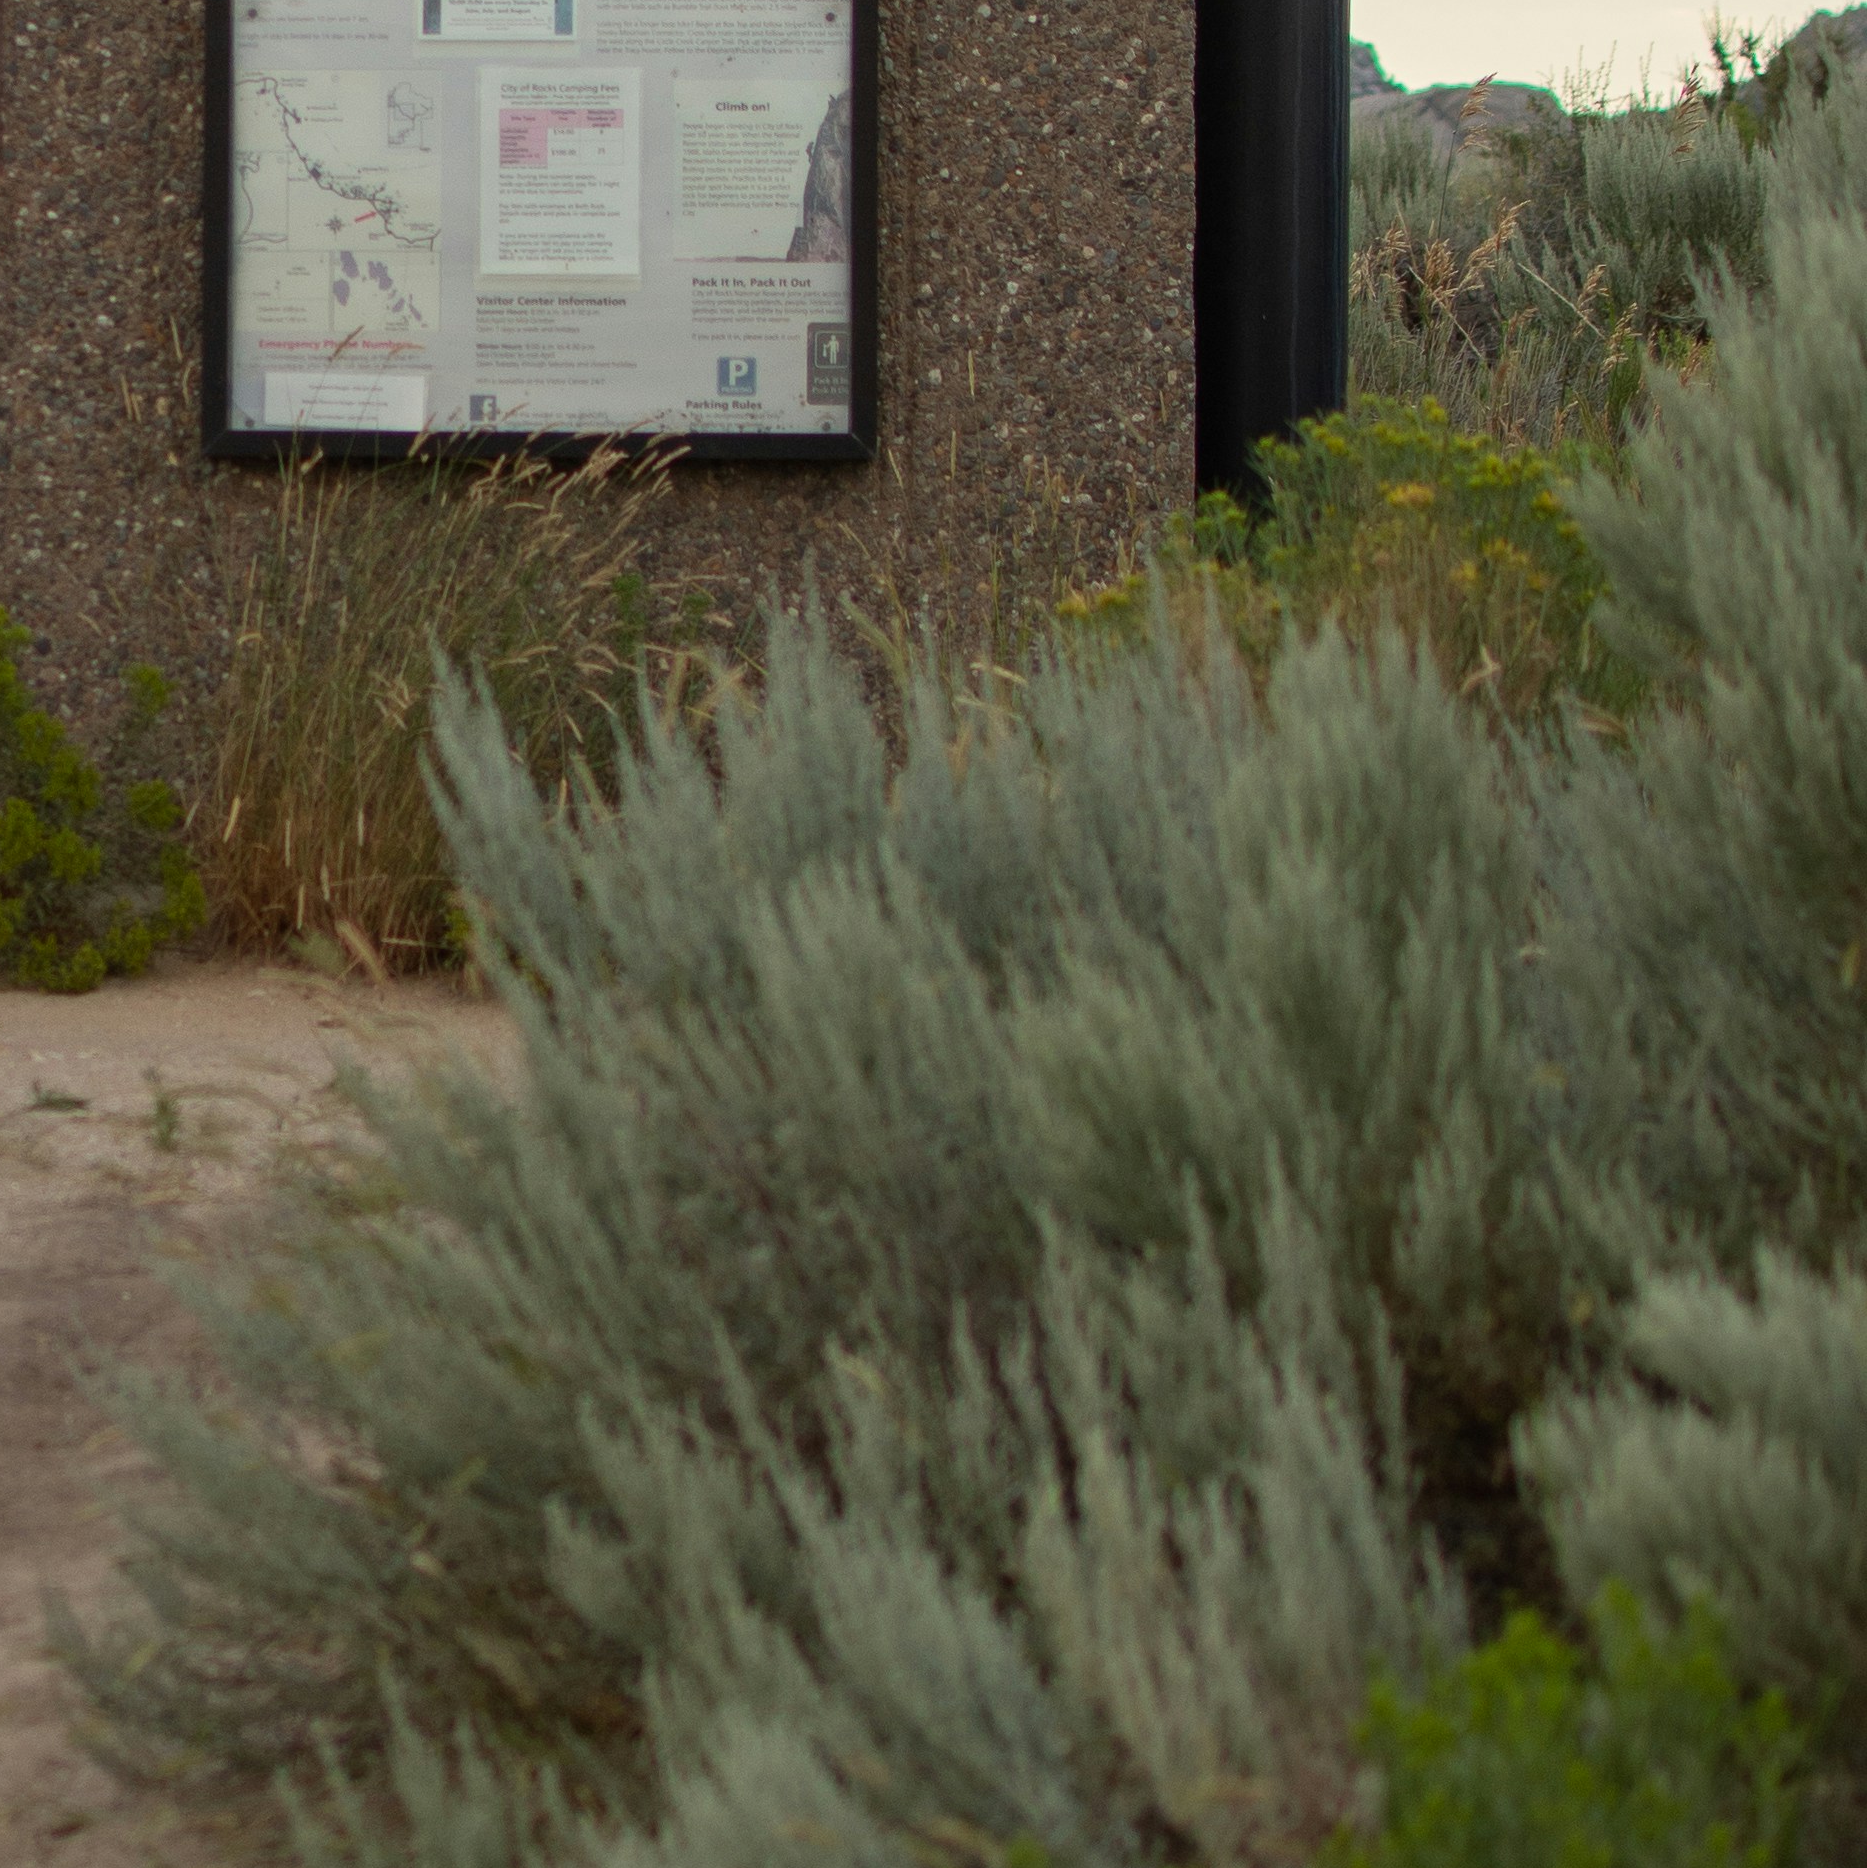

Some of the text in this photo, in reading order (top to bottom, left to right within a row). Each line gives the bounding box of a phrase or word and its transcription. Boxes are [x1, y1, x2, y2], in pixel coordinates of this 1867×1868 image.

[500, 84, 620, 94] City of Rocks Camping Fees
[715, 102, 770, 112] Climb on!
[692, 277, 811, 289] Pack It In, Pack It Out
[476, 296, 627, 306] Visitor Center Information
[258, 339, 320, 350] Emergency
[729, 359, 749, 386] P
[686, 400, 762, 411] Parking Rules
